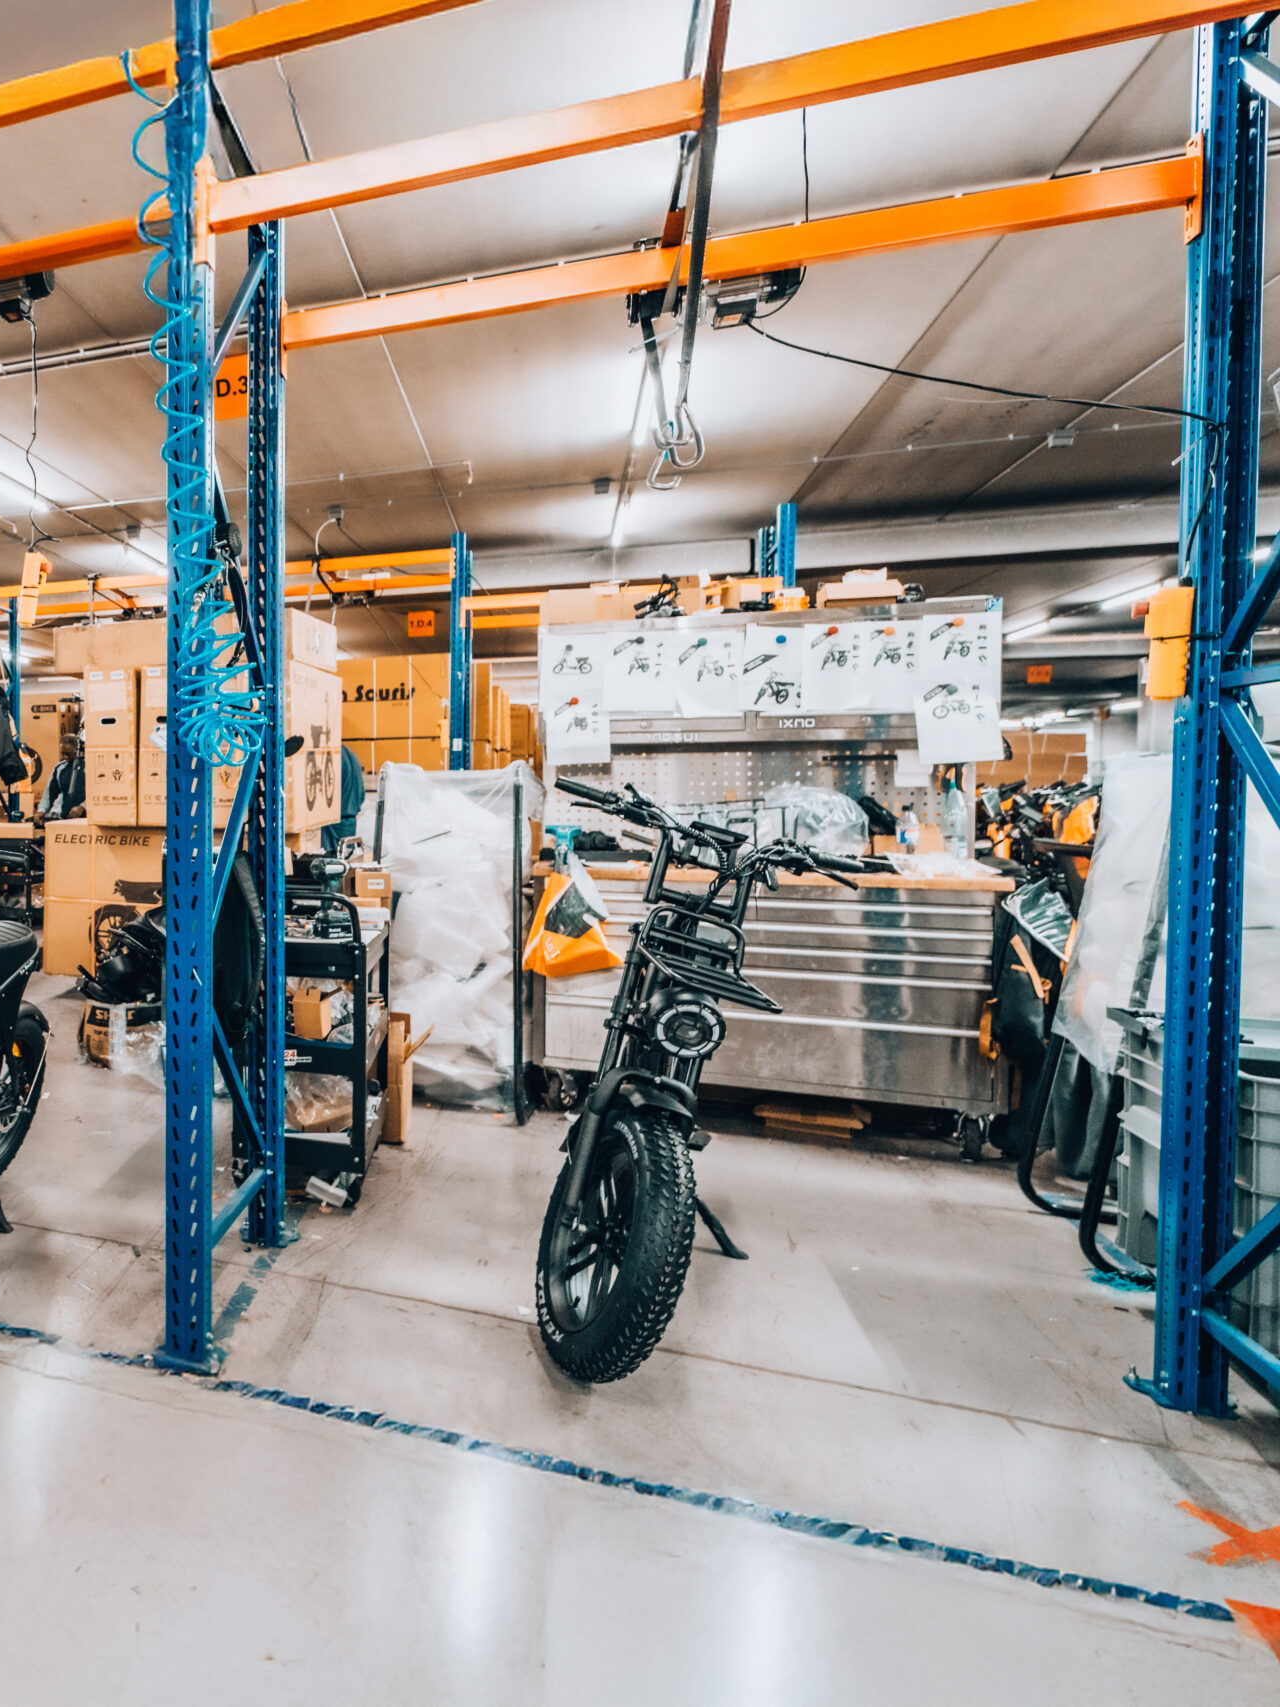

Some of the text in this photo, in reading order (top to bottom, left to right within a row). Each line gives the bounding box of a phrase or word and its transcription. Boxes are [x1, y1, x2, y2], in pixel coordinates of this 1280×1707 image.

[409, 619, 433, 629] 1.D.4
[54, 833, 151, 848] ELECTRIC BIKE
[537, 1267, 565, 1344] KENDA
